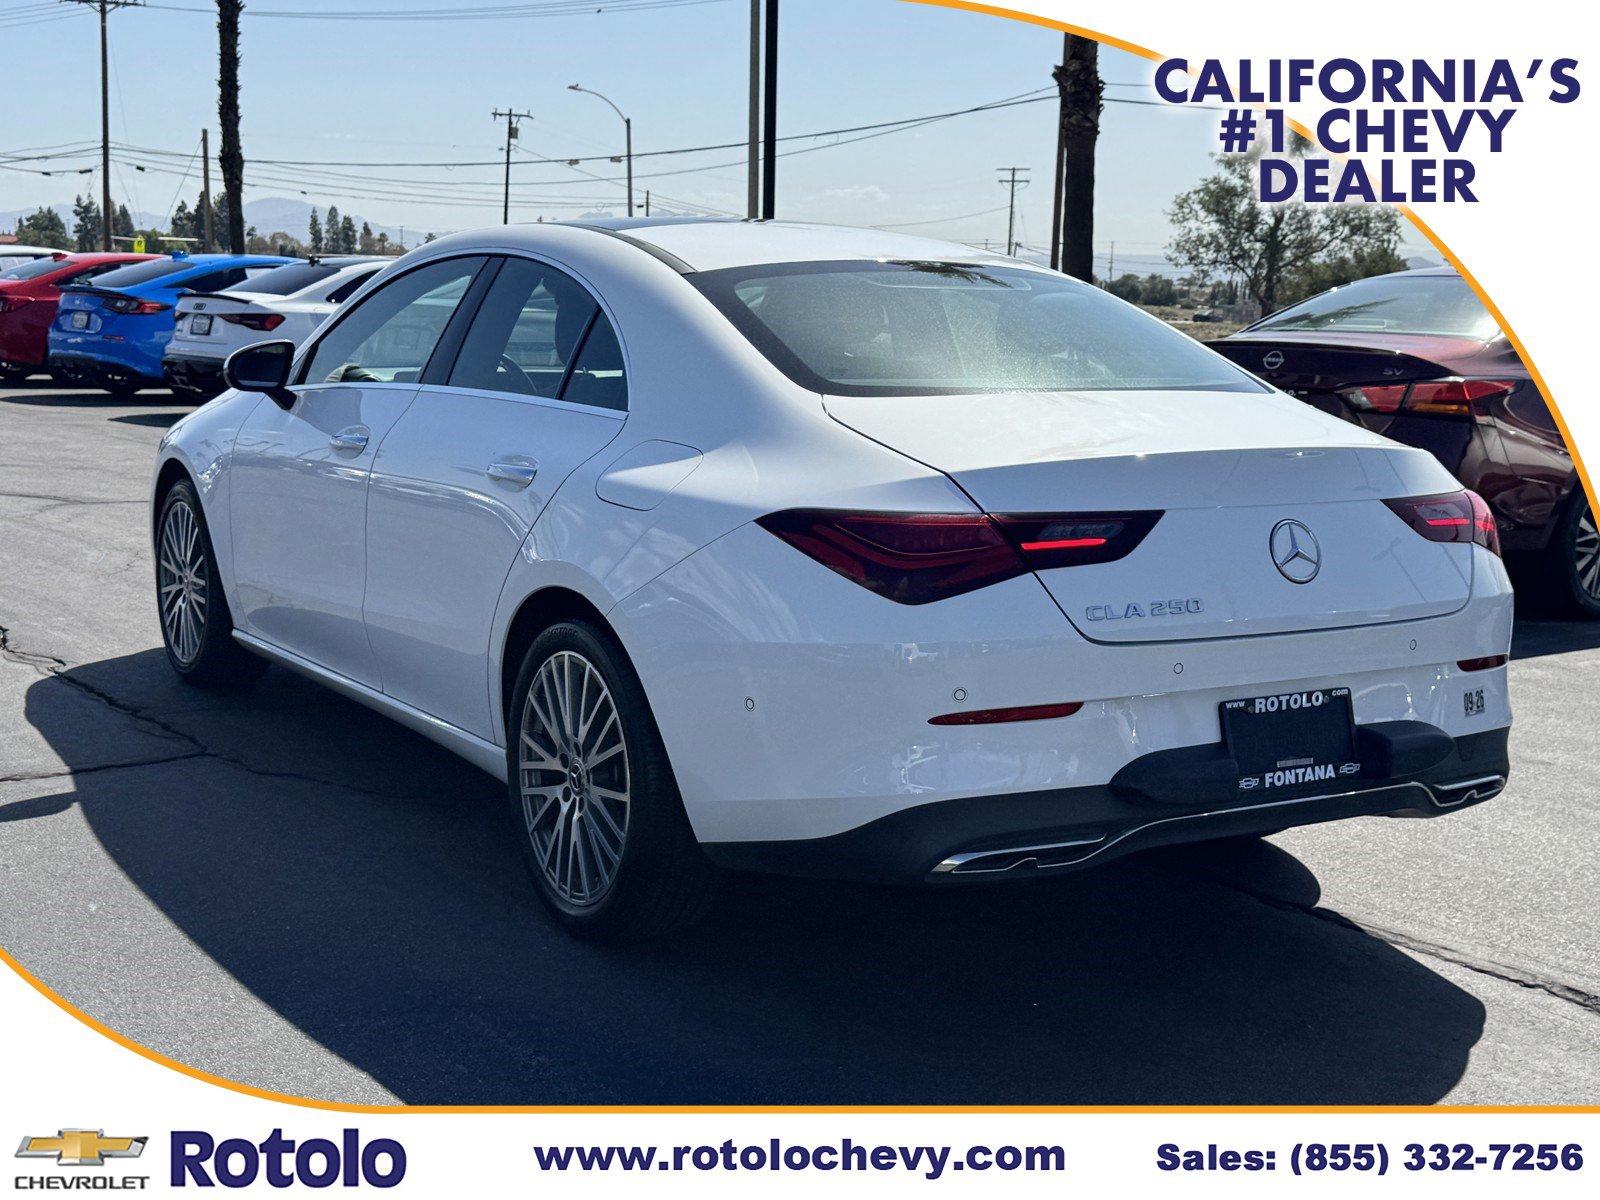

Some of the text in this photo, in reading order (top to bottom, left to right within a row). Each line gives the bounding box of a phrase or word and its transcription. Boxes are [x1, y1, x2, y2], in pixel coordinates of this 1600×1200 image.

[1086, 597, 1204, 622] CLA 250
[1226, 701, 1245, 709] www
[1255, 691, 1324, 714] ROTOLO
[1265, 764, 1336, 788] FONTANA
